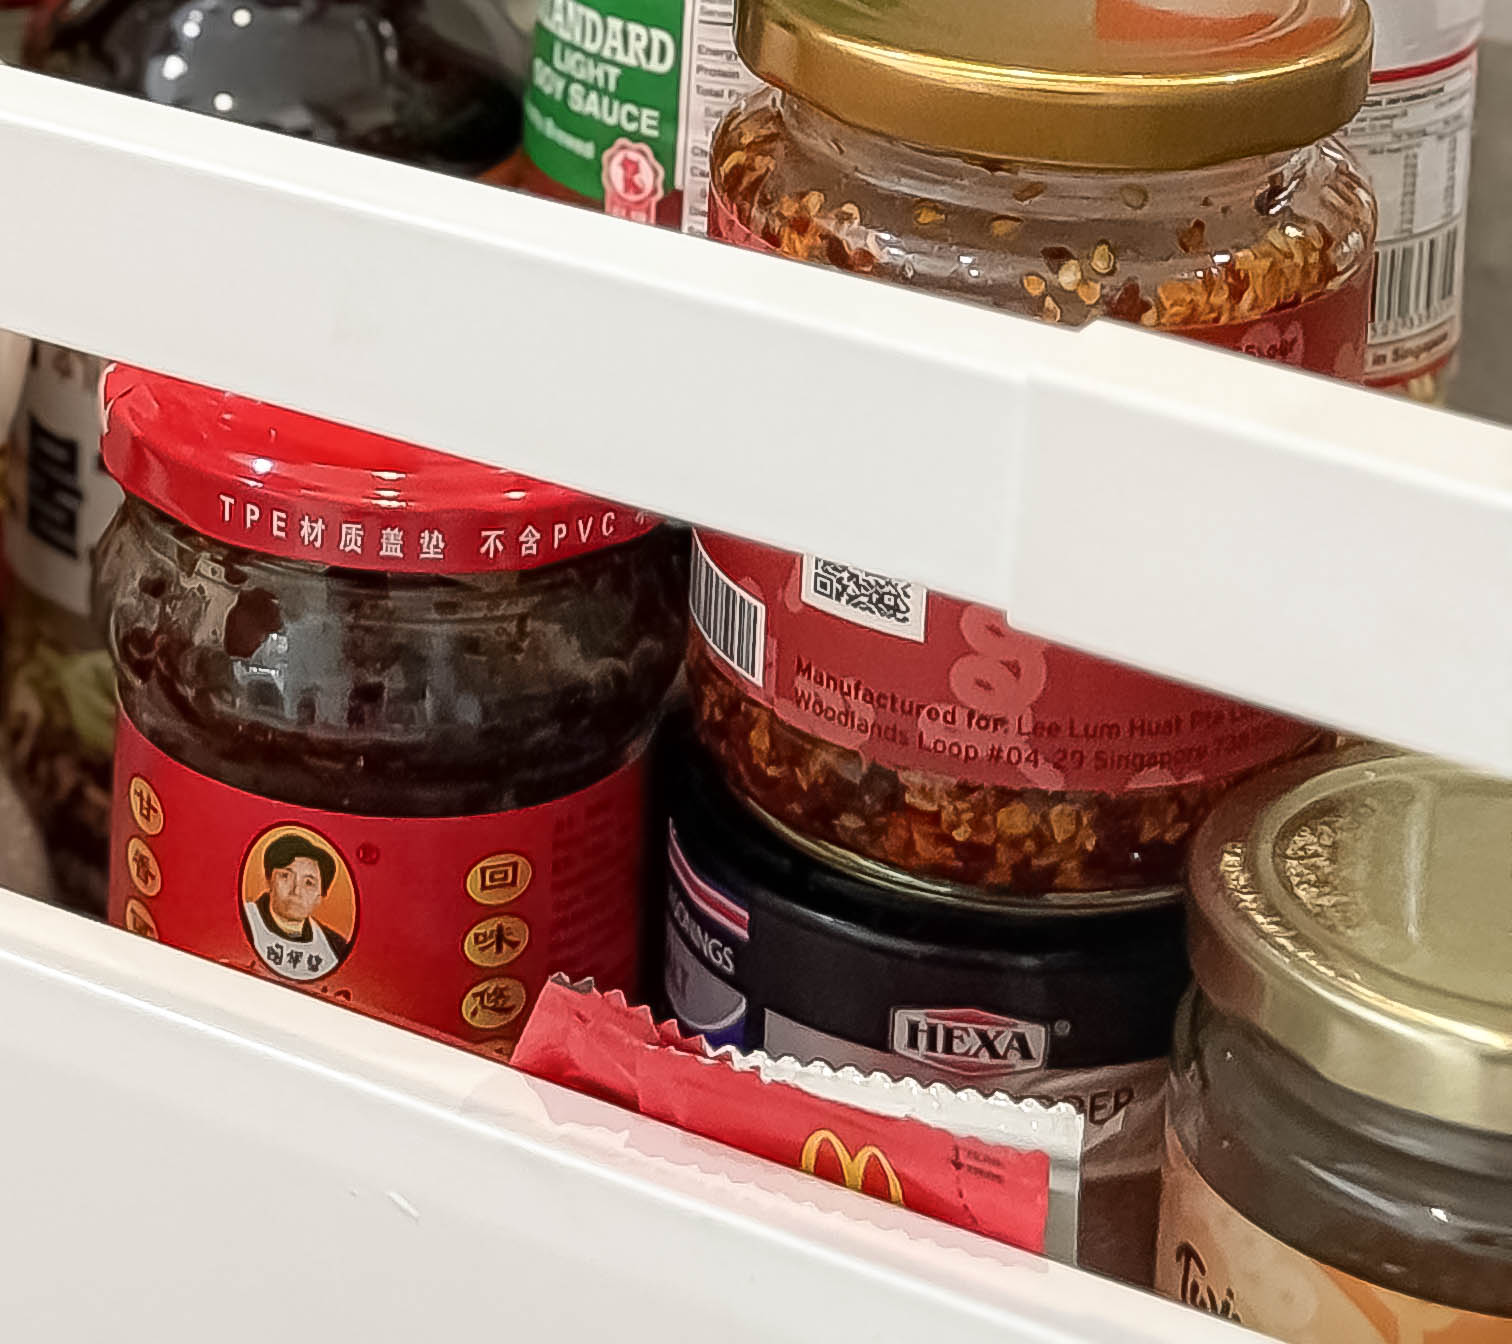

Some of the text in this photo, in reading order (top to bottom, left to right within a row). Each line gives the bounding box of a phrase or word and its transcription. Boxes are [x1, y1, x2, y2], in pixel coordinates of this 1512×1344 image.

[553, 40, 622, 92] LIGHT
[567, 81, 661, 138] SAUCE
[794, 655, 957, 727] Manufactured
[794, 686, 910, 746] Woodlands
[917, 730, 979, 764] Loop
[906, 1016, 1037, 1062] HEXA
